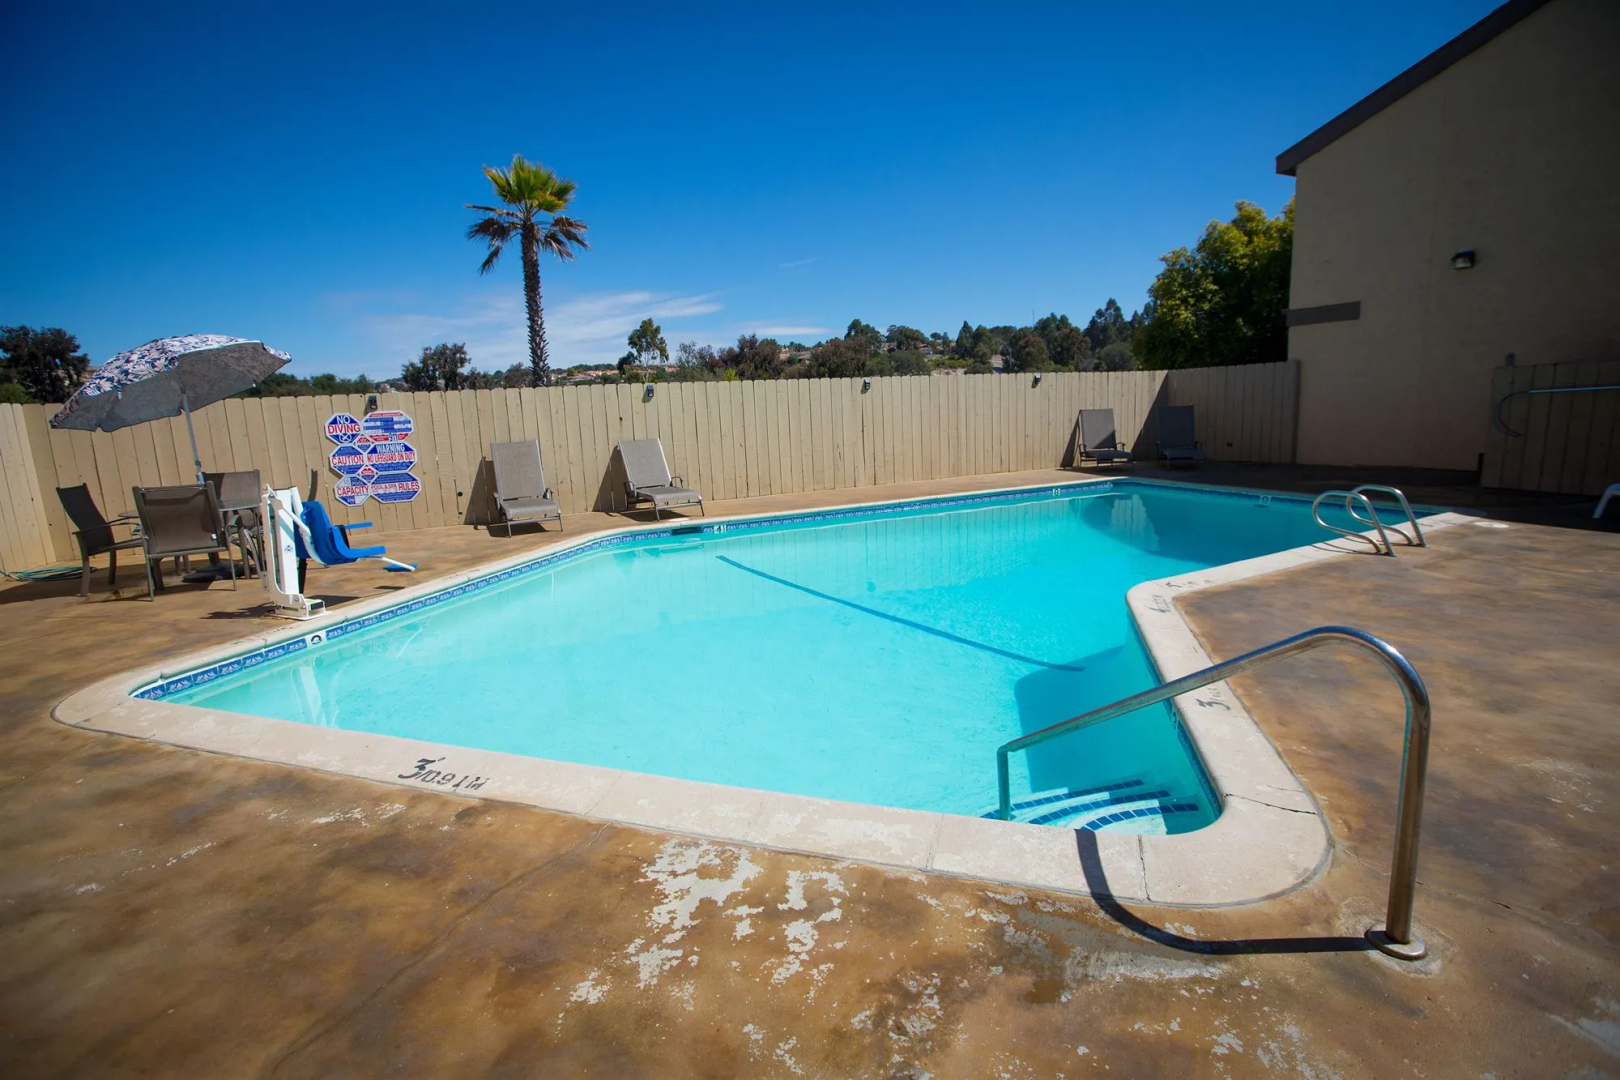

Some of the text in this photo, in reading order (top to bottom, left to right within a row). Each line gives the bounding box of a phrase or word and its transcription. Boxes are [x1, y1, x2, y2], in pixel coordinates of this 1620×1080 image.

[336, 415, 350, 424] NO
[328, 423, 361, 434] DIVING
[376, 443, 405, 453] WARNING
[331, 455, 364, 465] CAUTION
[367, 452, 415, 463] NO LIFEGUARD ON DUTY
[337, 485, 369, 496] CAPACITY
[398, 482, 420, 491] RULES
